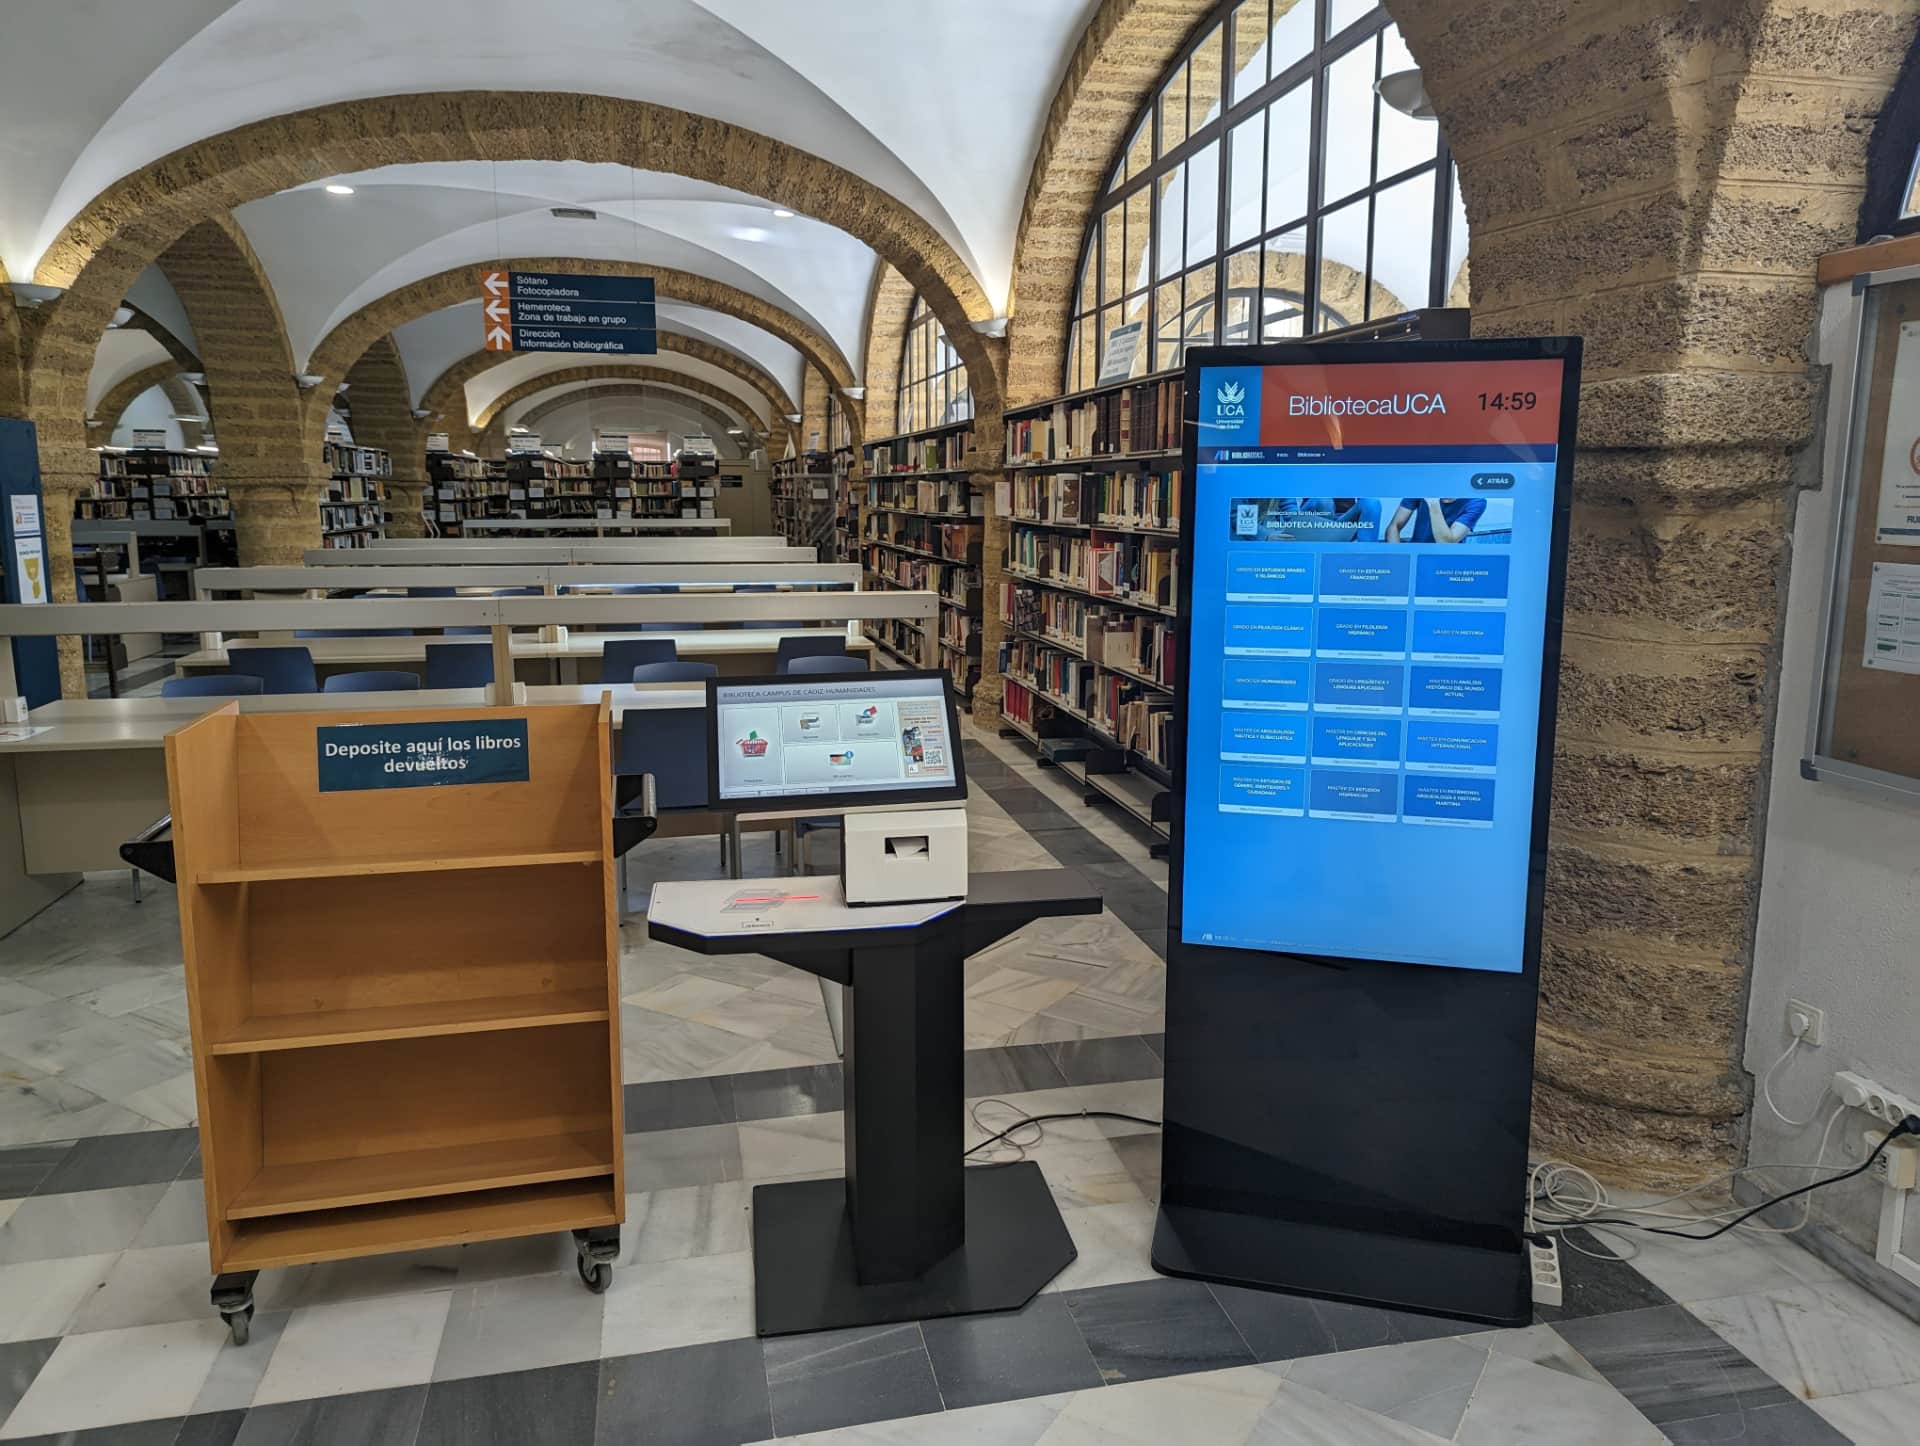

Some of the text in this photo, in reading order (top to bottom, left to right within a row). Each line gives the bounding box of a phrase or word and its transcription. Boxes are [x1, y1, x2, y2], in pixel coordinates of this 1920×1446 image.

[517, 275, 548, 285] Sótano
[517, 286, 580, 297] Fotocopiadora
[518, 302, 571, 312] Hemeroteca
[518, 312, 541, 321] Zona
[543, 312, 554, 322] de
[556, 313, 587, 325] trabajo
[602, 316, 627, 326] grupo
[519, 329, 560, 339] Dirección
[520, 339, 624, 351] Información bibliográfica
[1288, 393, 1447, 416] BibliotecaUCA
[1478, 391, 1537, 411] 14:59
[1216, 404, 1245, 416] UCA
[1487, 476, 1509, 485] ATRÁS
[1266, 520, 1375, 529] BIBLIOTECA HUMANIDADES
[722, 690, 761, 699] BIBLIOTECA
[761, 689, 791, 698] CAMPUS
[792, 688, 803, 696] DE
[825, 685, 877, 695] HUMANIDADES
[325, 735, 521, 759] Deposite aquí los libros
[383, 756, 467, 773] devueltos
